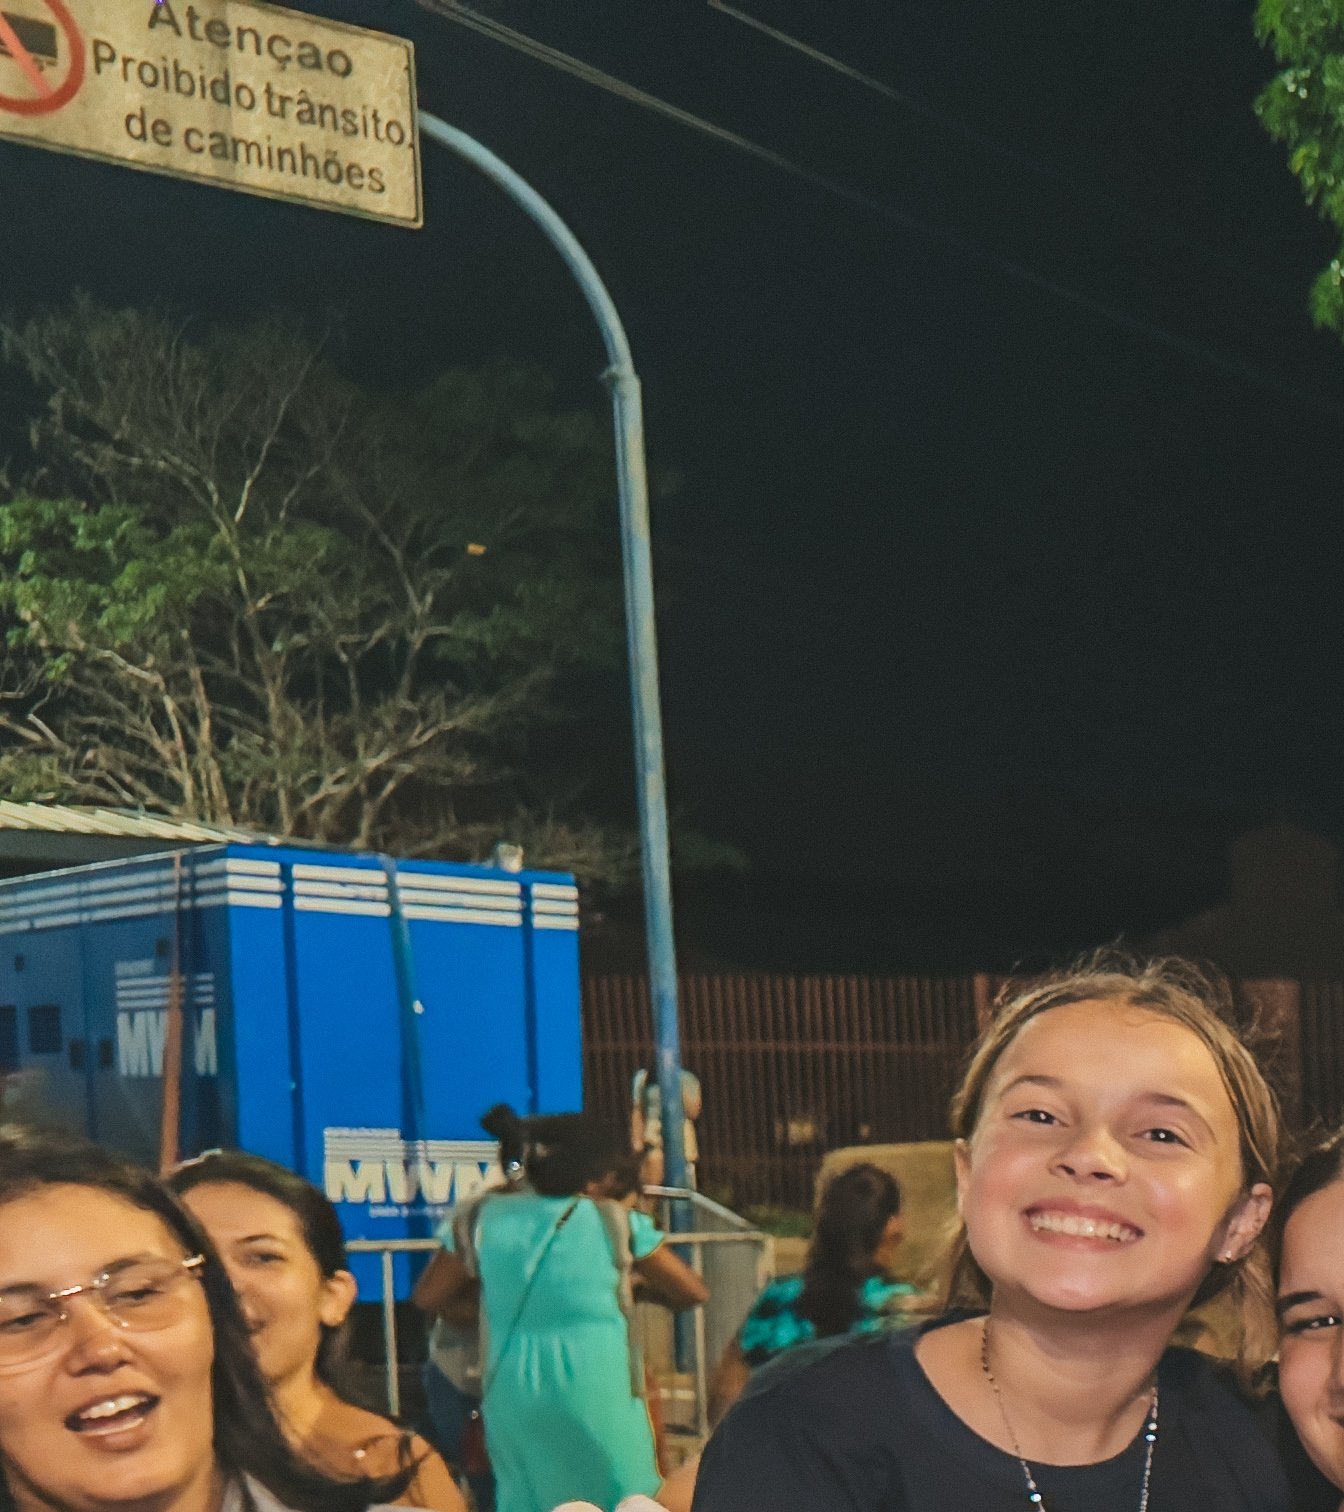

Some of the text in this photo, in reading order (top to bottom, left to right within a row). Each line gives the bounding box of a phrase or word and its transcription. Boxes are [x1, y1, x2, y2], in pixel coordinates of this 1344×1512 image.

[92, 39, 406, 146] Proibido trânsito
[125, 106, 386, 193] de caminhões
